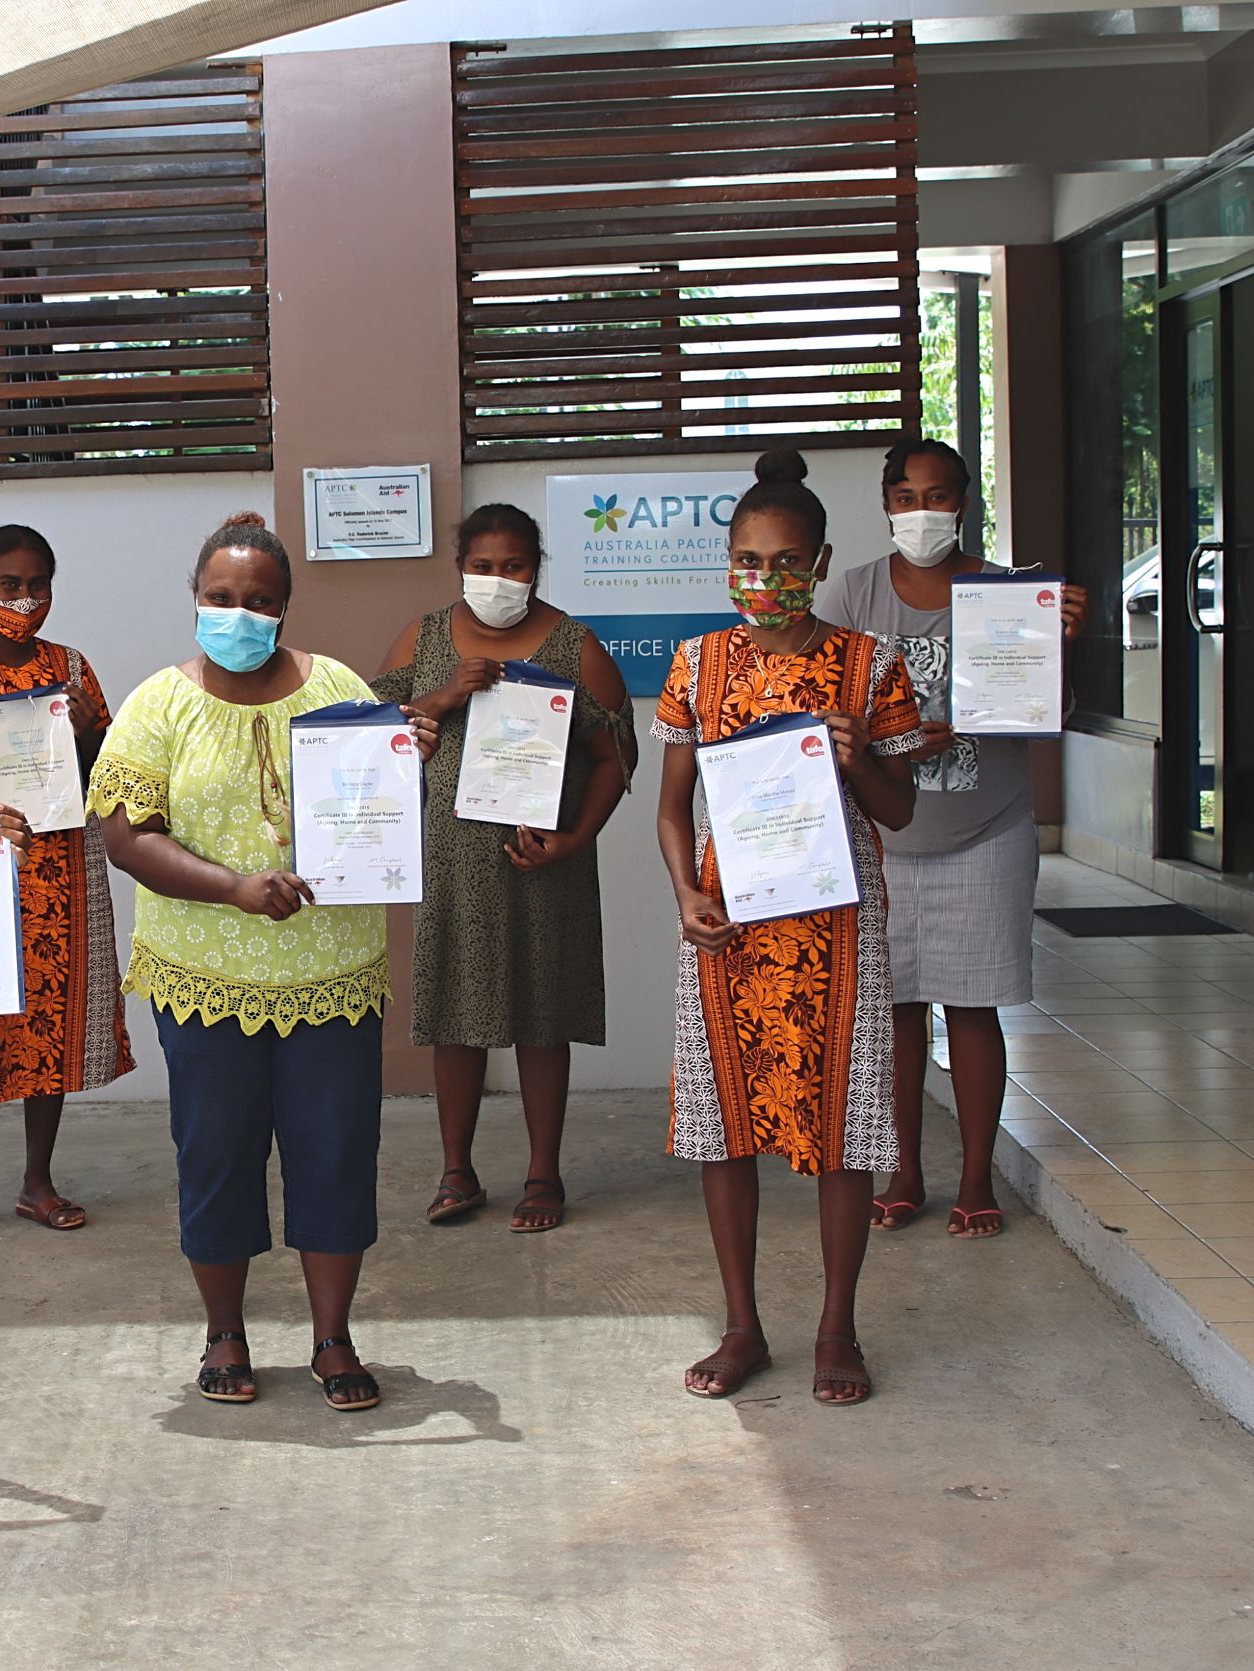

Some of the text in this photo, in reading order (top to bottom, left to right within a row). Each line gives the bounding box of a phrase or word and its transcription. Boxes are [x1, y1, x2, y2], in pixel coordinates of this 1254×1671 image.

[325, 484, 347, 492] APTC
[628, 494, 737, 528] APTC
[584, 540, 670, 551] AUSTRALIA
[584, 555, 652, 565] TRAINING
[583, 578, 639, 588] Creating
[646, 576, 681, 586] Skills
[689, 576, 707, 585] For
[714, 752, 736, 762] APTC
[803, 815, 825, 823] Support
